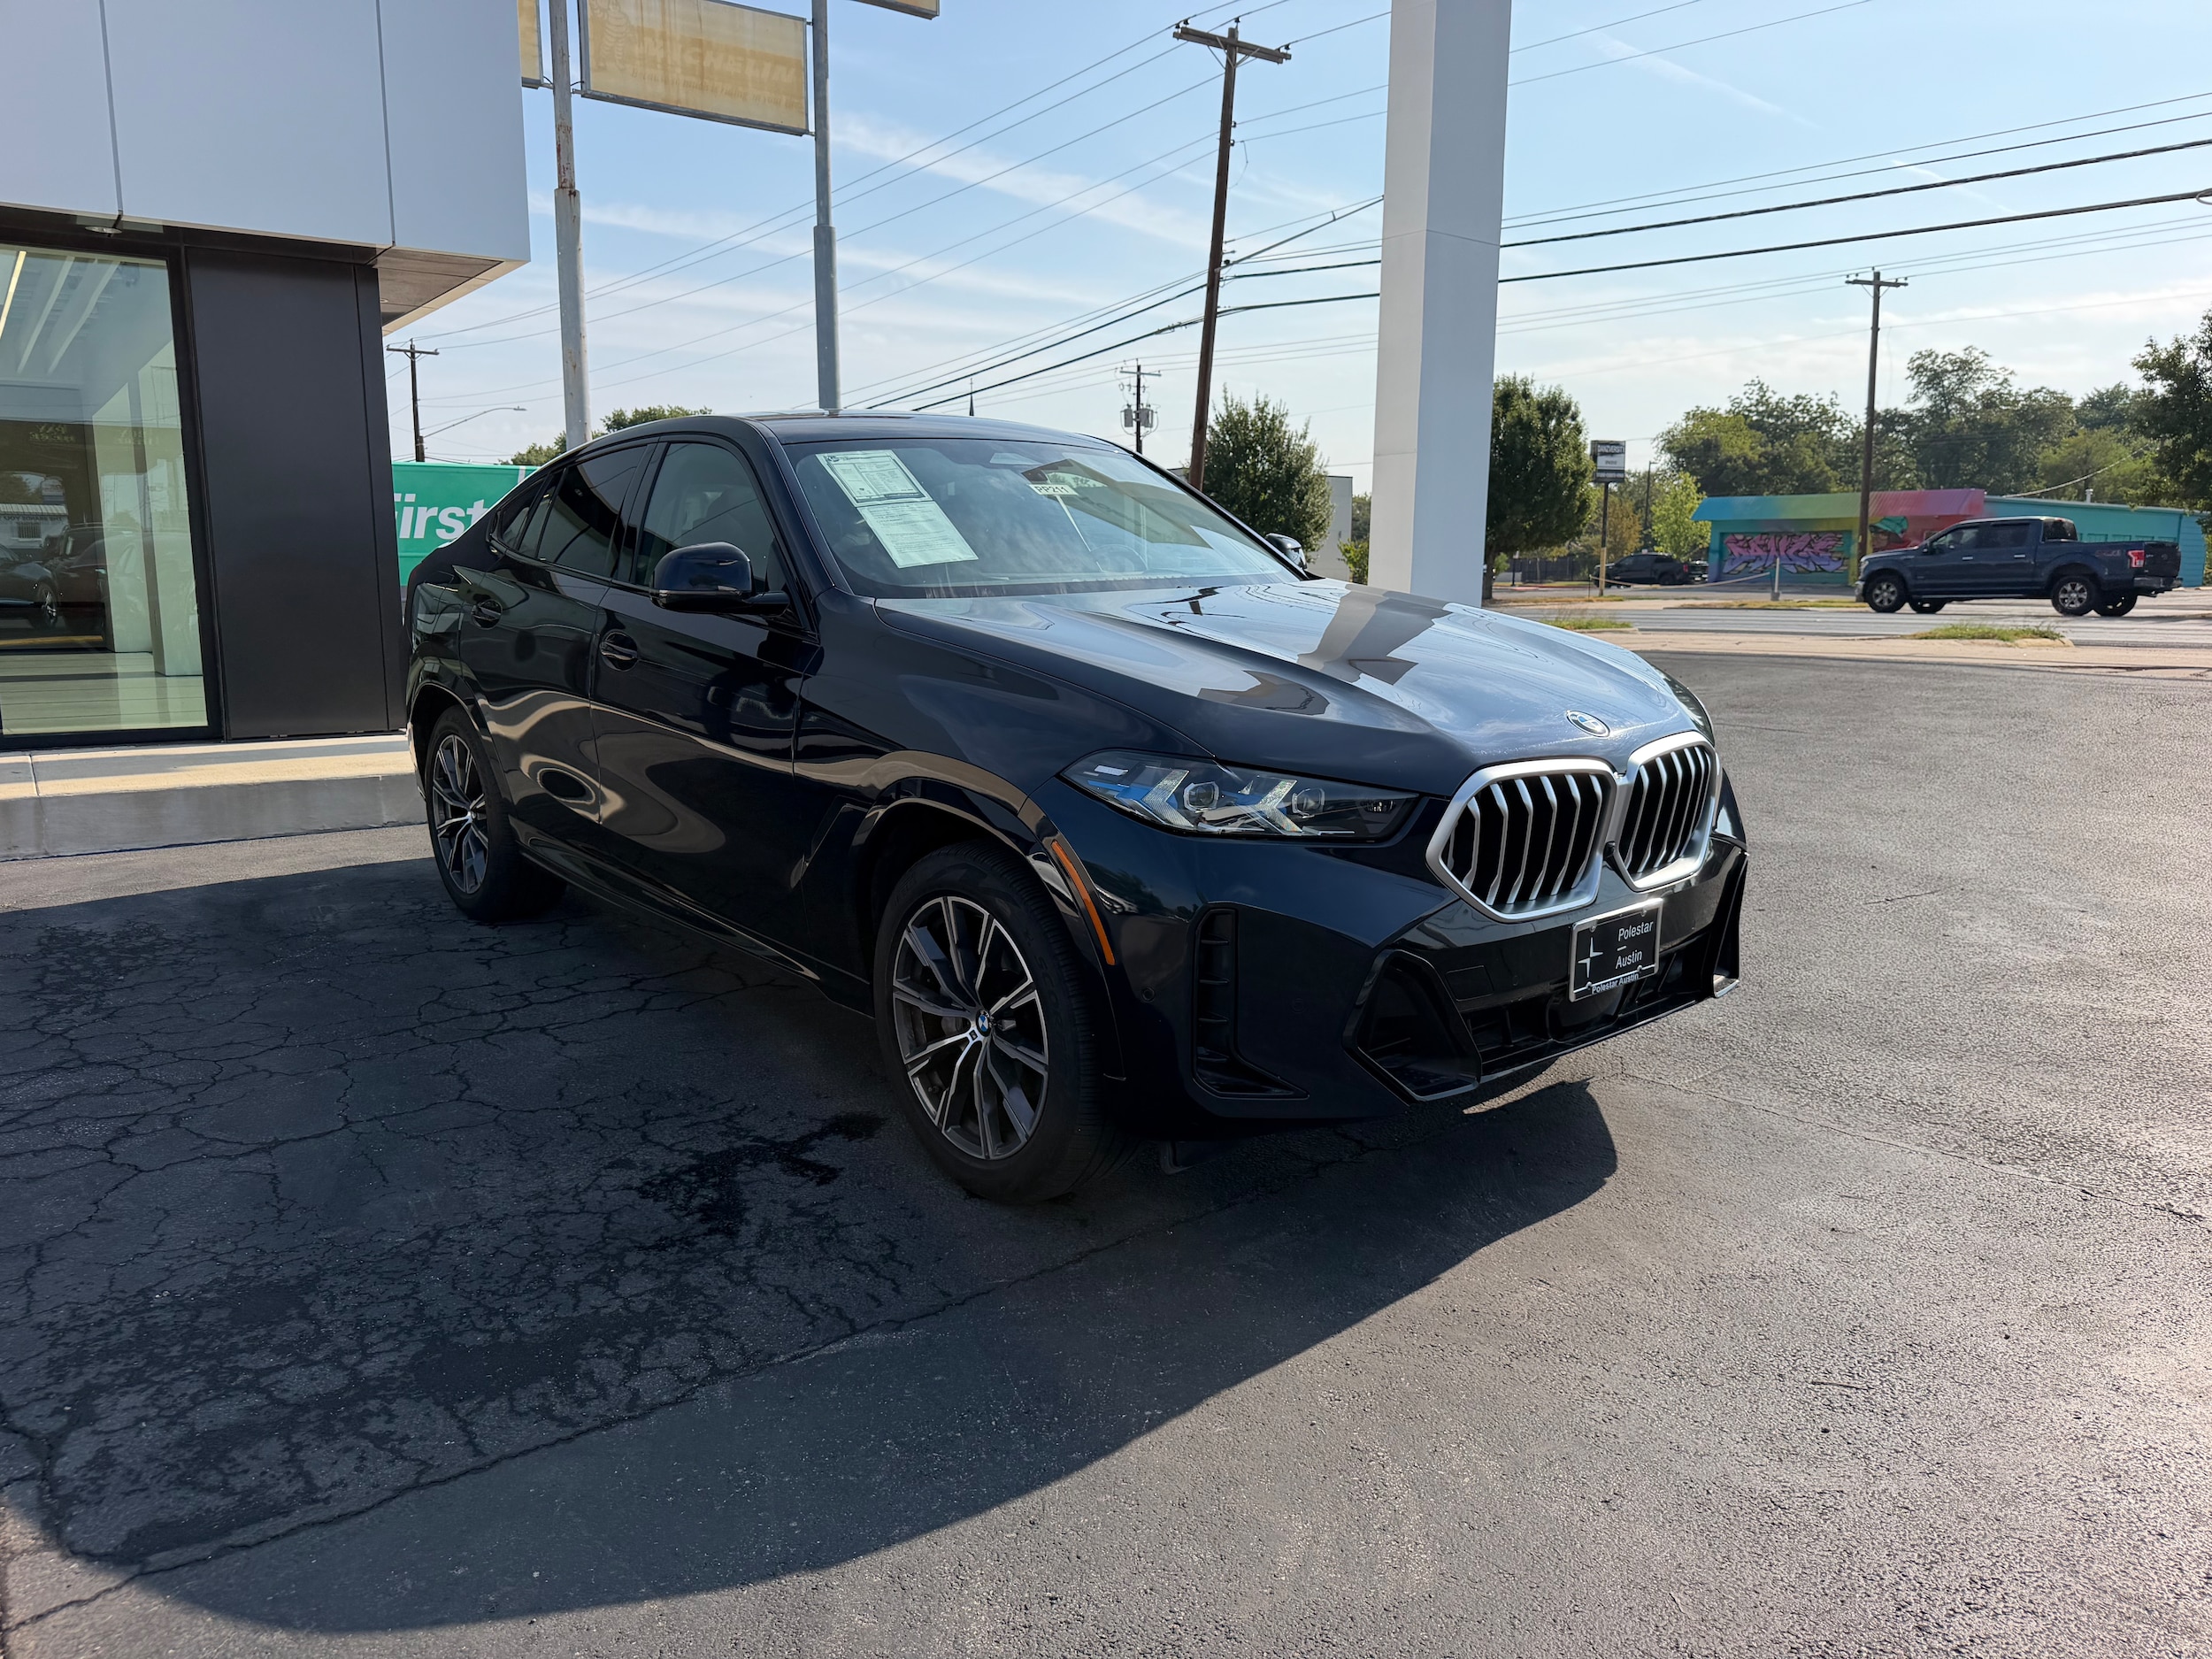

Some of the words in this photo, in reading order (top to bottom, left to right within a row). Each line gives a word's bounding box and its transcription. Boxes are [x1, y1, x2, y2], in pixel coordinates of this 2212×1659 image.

[635, 37, 796, 82] MICHELIN
[1617, 921, 1654, 941] Polestar
[1616, 949, 1643, 970] Austin
[1591, 980, 1618, 994] Polestar
[1618, 972, 1639, 985] Austin
